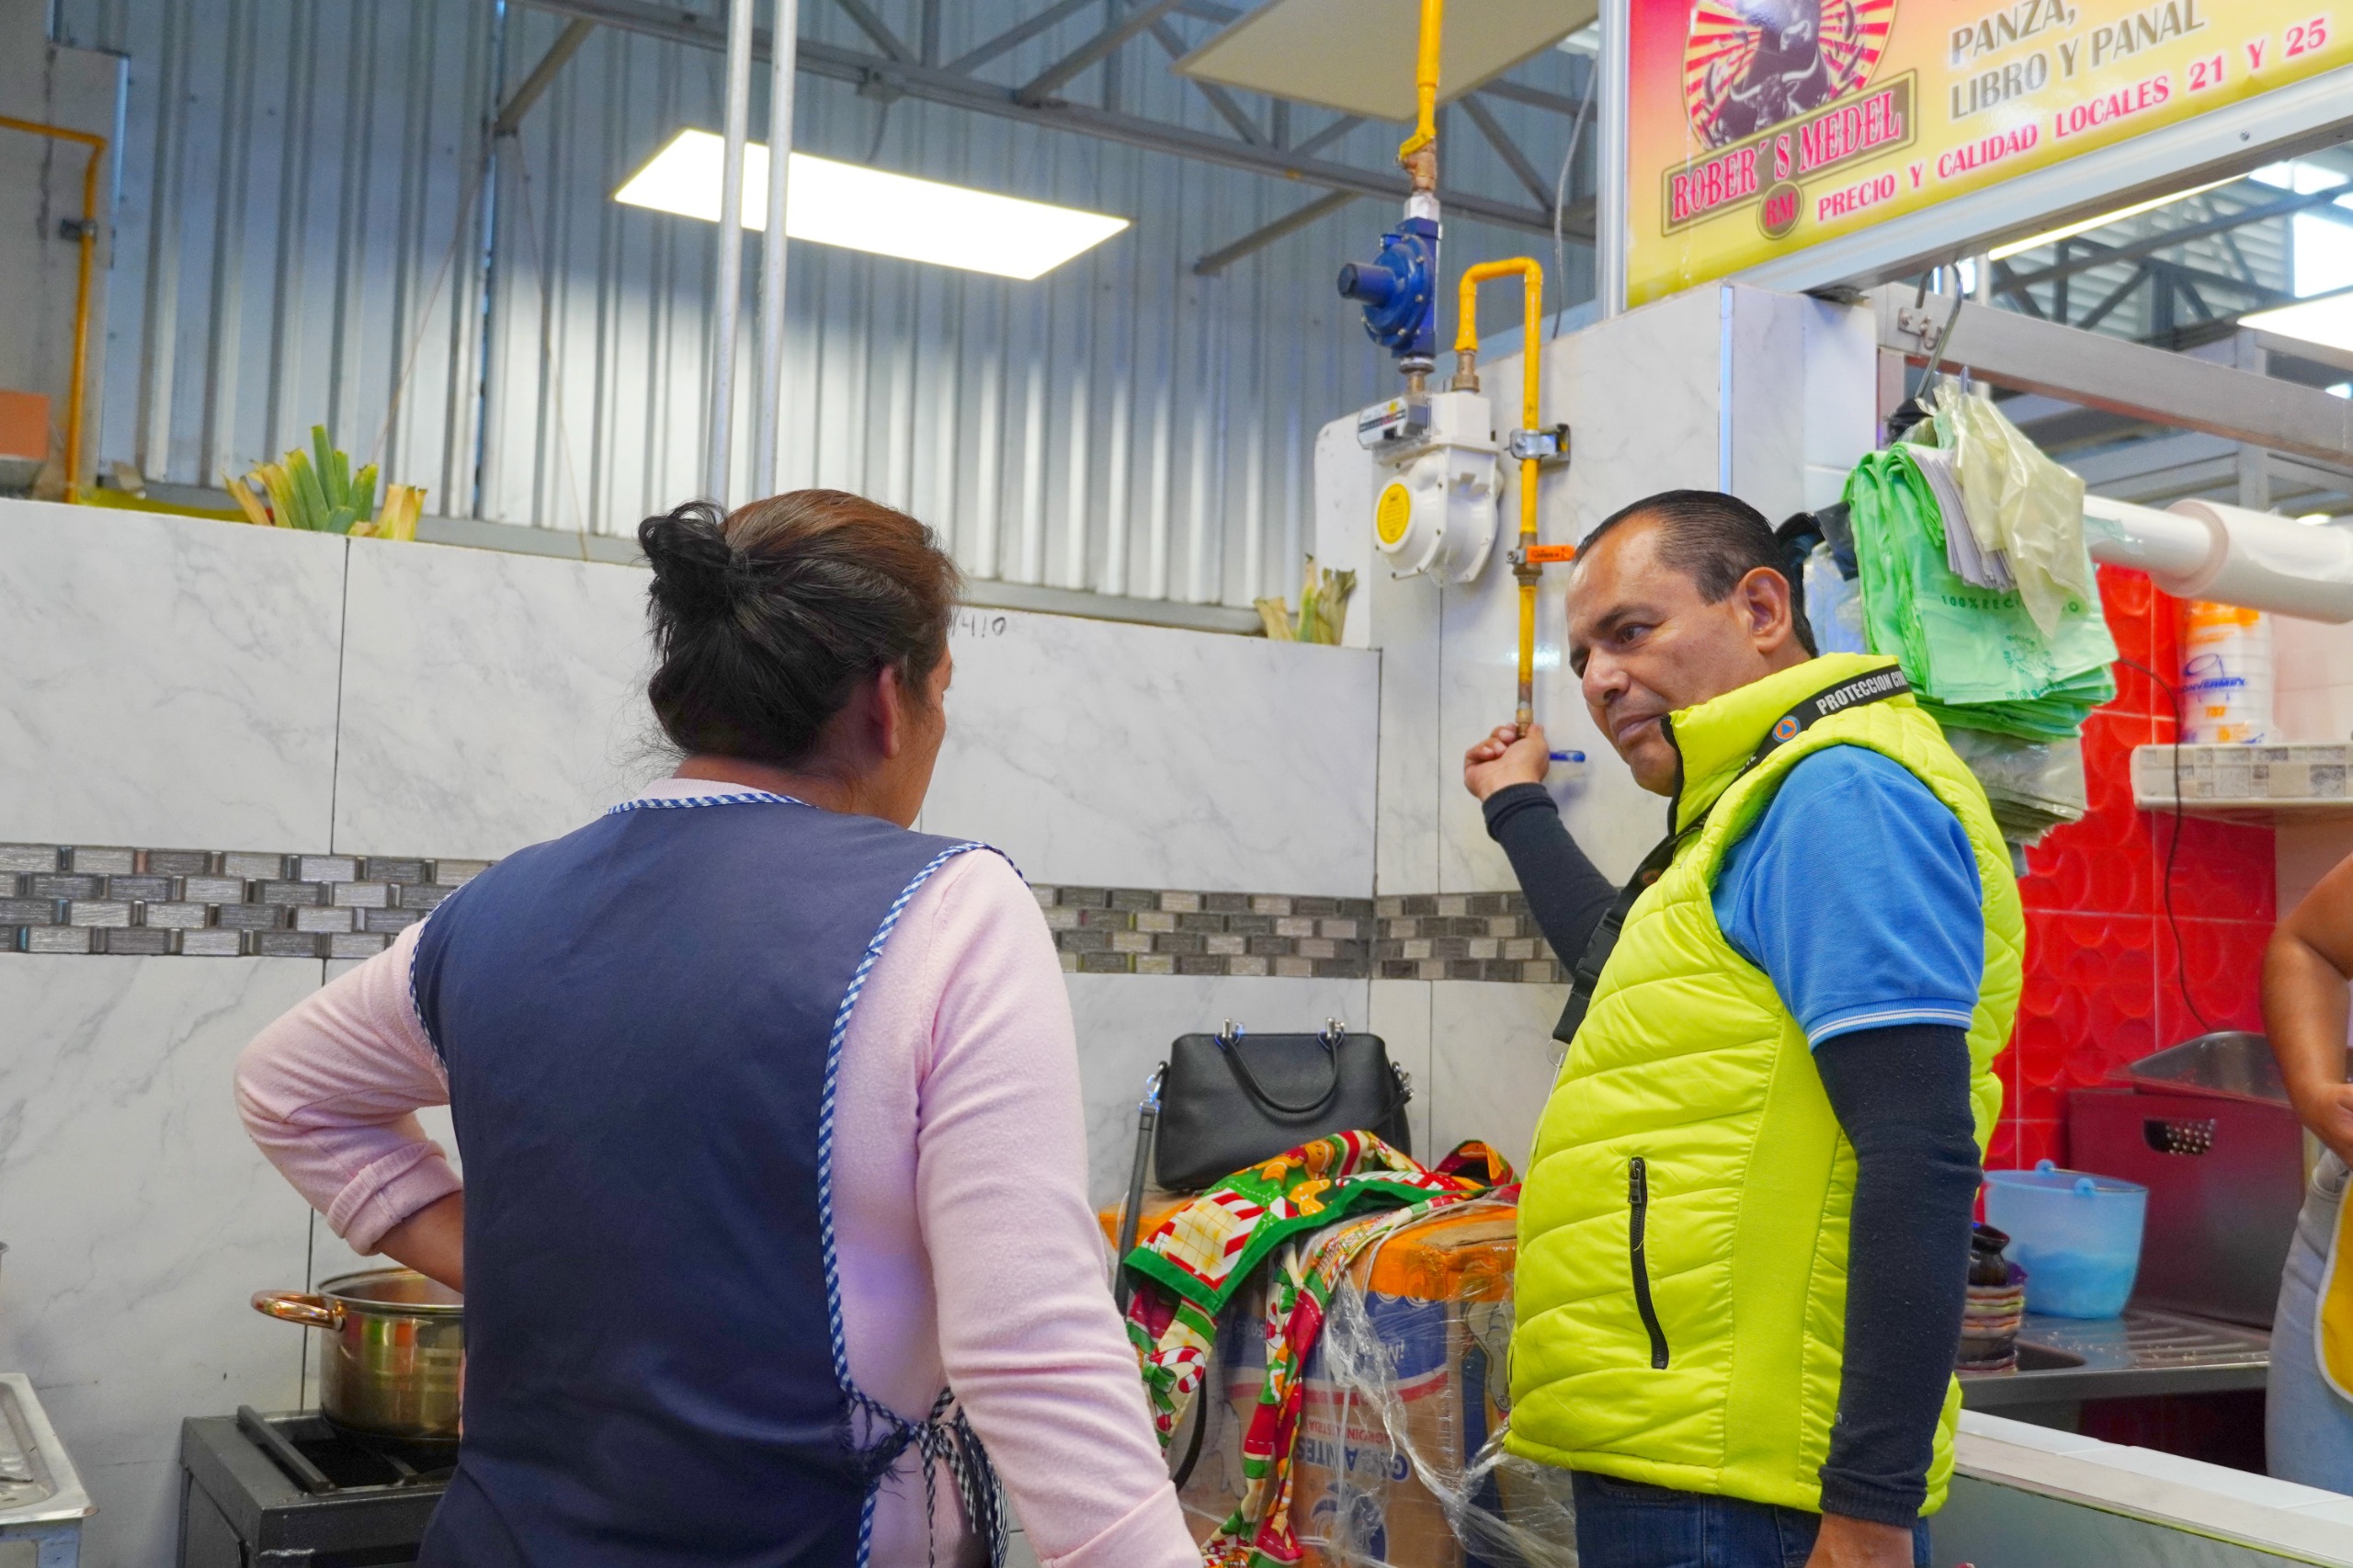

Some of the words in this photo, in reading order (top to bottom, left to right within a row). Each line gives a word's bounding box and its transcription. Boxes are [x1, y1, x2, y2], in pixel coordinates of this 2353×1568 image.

[1950, 0, 2075, 65] PANZA,
[1950, 52, 2047, 119] LIBRO
[2059, 39, 2078, 77] Y
[2091, 0, 2205, 67] PANAL
[1797, 91, 1901, 174] MEDEL
[1817, 174, 1895, 222] PRECIO
[1909, 164, 1923, 187] Y
[1937, 123, 2038, 178] CALIDAD
[2055, 75, 2169, 138] LOCALES
[2189, 55, 2222, 91] 21
[2247, 40, 2265, 70] Y
[2286, 17, 2326, 57] 25
[1765, 191, 1795, 228] RM
[1815, 673, 1893, 715] PROTECCION
